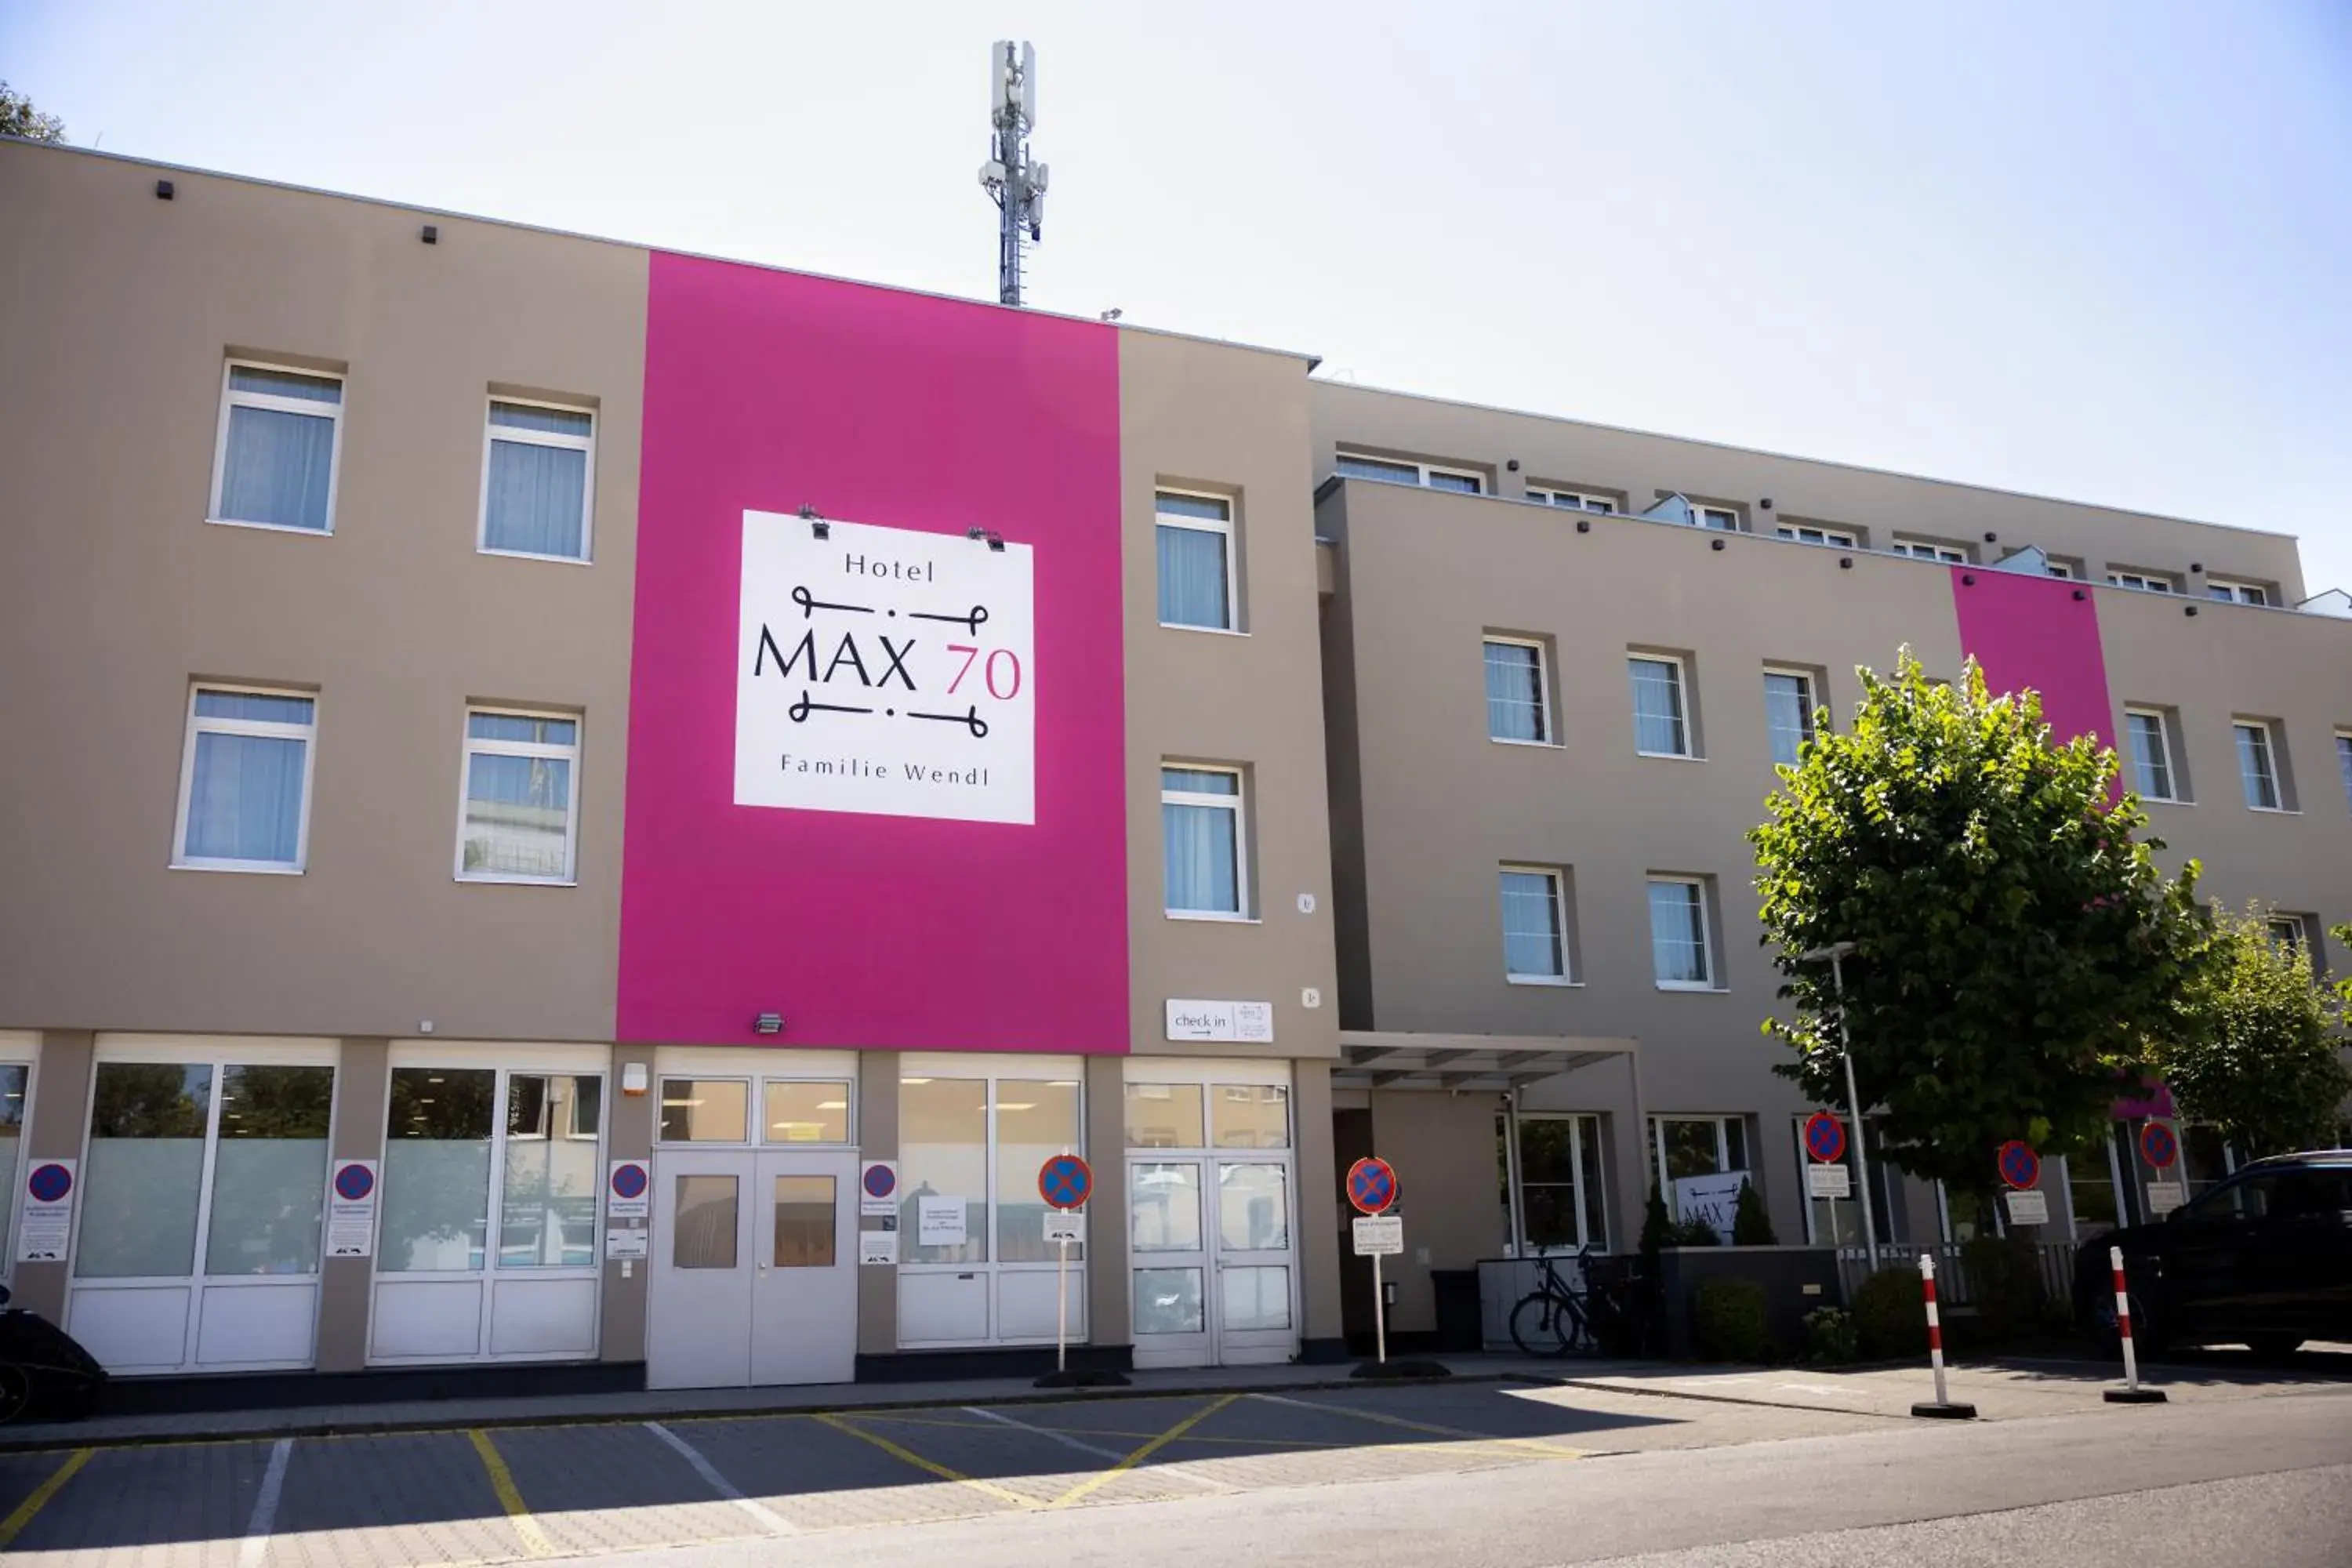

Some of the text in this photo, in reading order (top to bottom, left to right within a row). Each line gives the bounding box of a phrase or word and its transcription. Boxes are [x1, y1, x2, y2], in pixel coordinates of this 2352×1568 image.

[845, 554, 933, 583] Hotel
[753, 623, 1021, 700] MAX 70
[781, 754, 988, 786] Familie Wendl
[1175, 1013, 1226, 1028] check in
[1684, 1202, 1723, 1225] MAX
